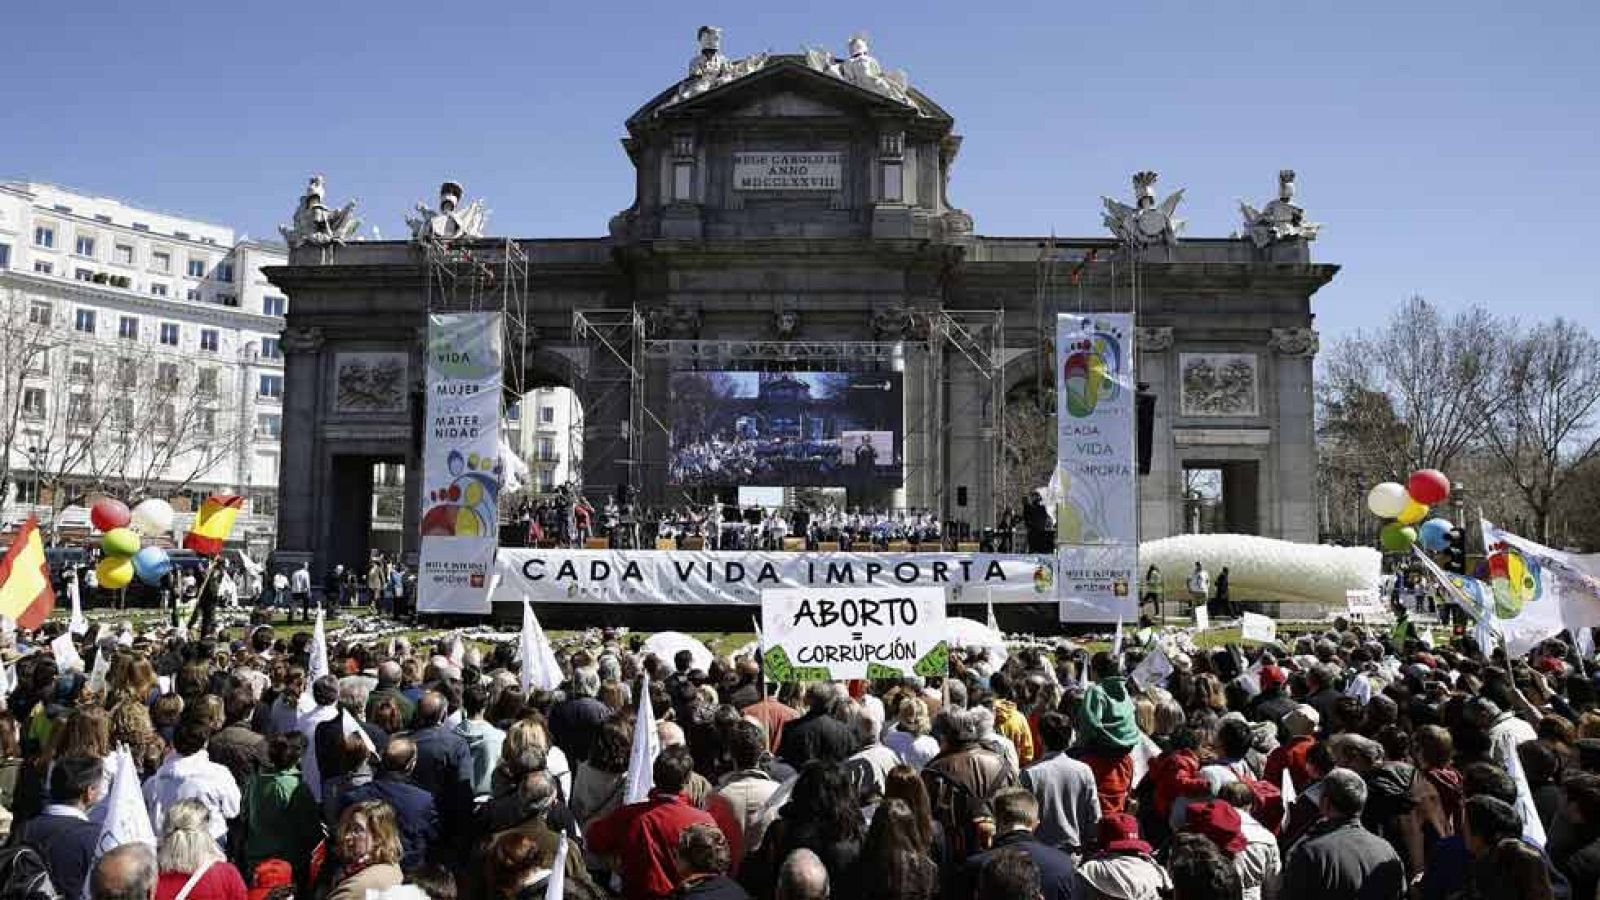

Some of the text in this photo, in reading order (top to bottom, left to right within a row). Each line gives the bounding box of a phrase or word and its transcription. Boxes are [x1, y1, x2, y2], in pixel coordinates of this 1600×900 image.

[769, 166, 808, 176] ANNO
[438, 352, 470, 364] VIDA
[437, 384, 479, 396] MUJER
[435, 416, 479, 427] MATER
[435, 428, 479, 439] NIDAD
[1063, 425, 1100, 437] CADA
[1072, 443, 1113, 456] VIDA
[522, 558, 1007, 584] CADA VIDA IMPORTA
[793, 597, 917, 627] ABORTO
[797, 637, 917, 663] CORRUPCIÓN
